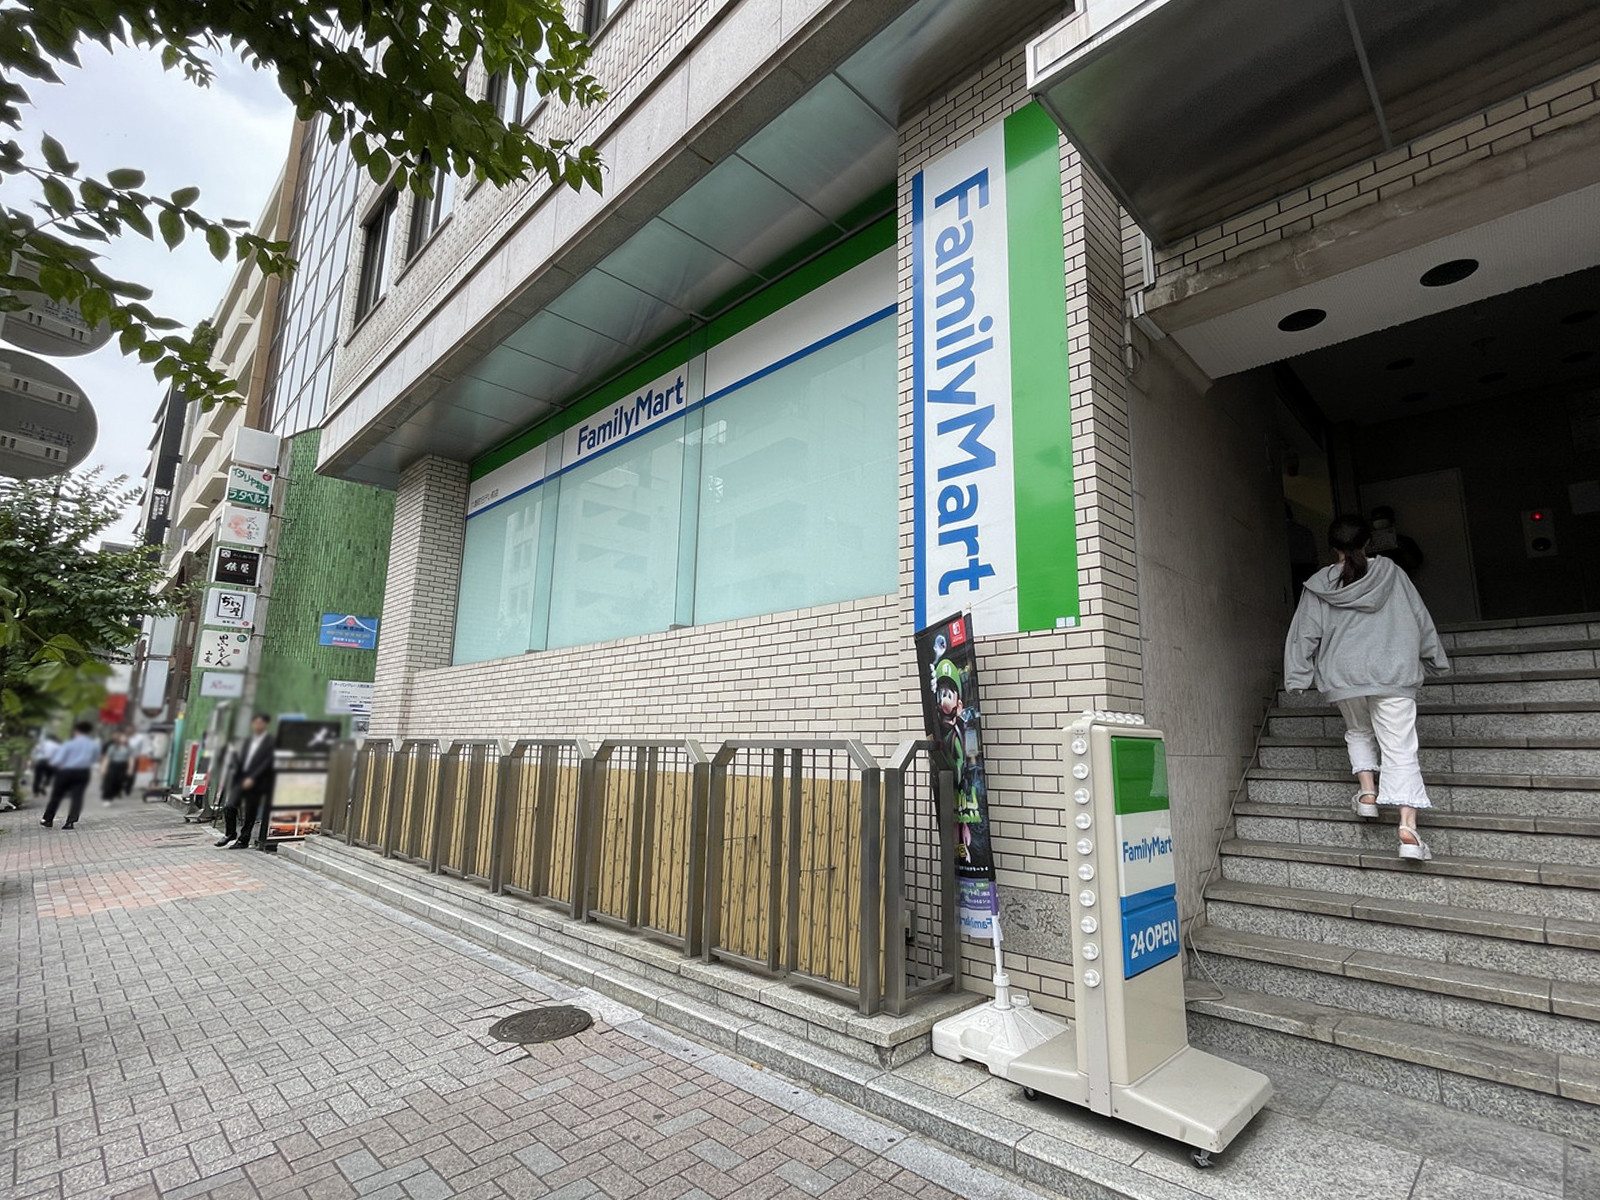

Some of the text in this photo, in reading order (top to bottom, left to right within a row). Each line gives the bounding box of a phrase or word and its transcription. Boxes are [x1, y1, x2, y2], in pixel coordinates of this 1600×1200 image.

[577, 376, 685, 456] FamilyMart
[926, 166, 996, 597] FamilyMart
[1123, 836, 1173, 864] FamilyMart
